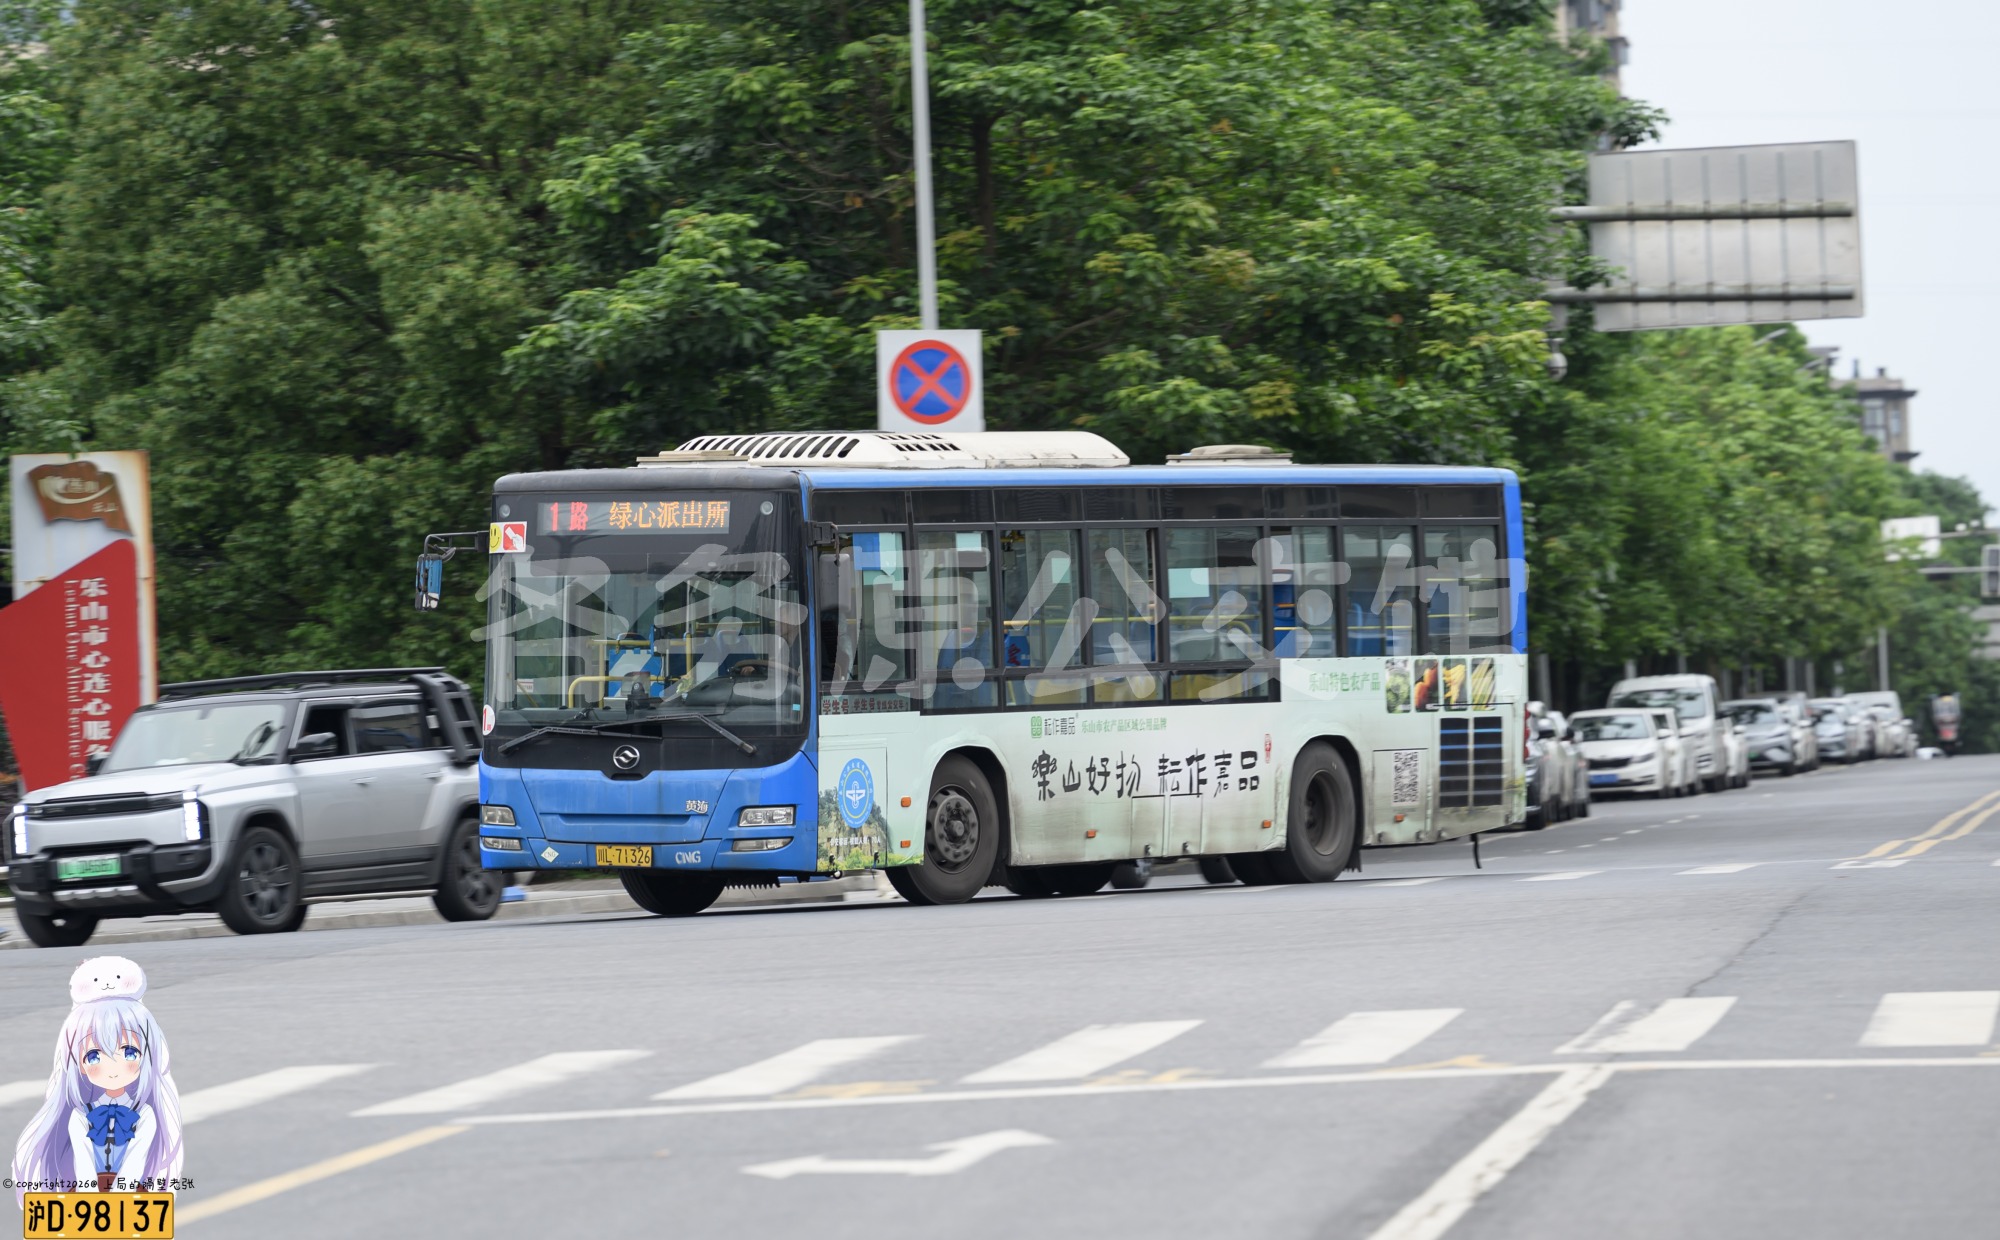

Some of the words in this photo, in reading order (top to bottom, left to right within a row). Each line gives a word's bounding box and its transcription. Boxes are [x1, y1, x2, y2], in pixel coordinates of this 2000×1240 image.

[609, 500, 729, 530] 绿心派出所
[1308, 671, 1382, 693] 乐山特色农产品
[822, 699, 849, 715] 学生号
[1157, 748, 1260, 799] 耘作嘉品
[685, 800, 709, 814] 黄海
[675, 851, 702, 865] CNG
